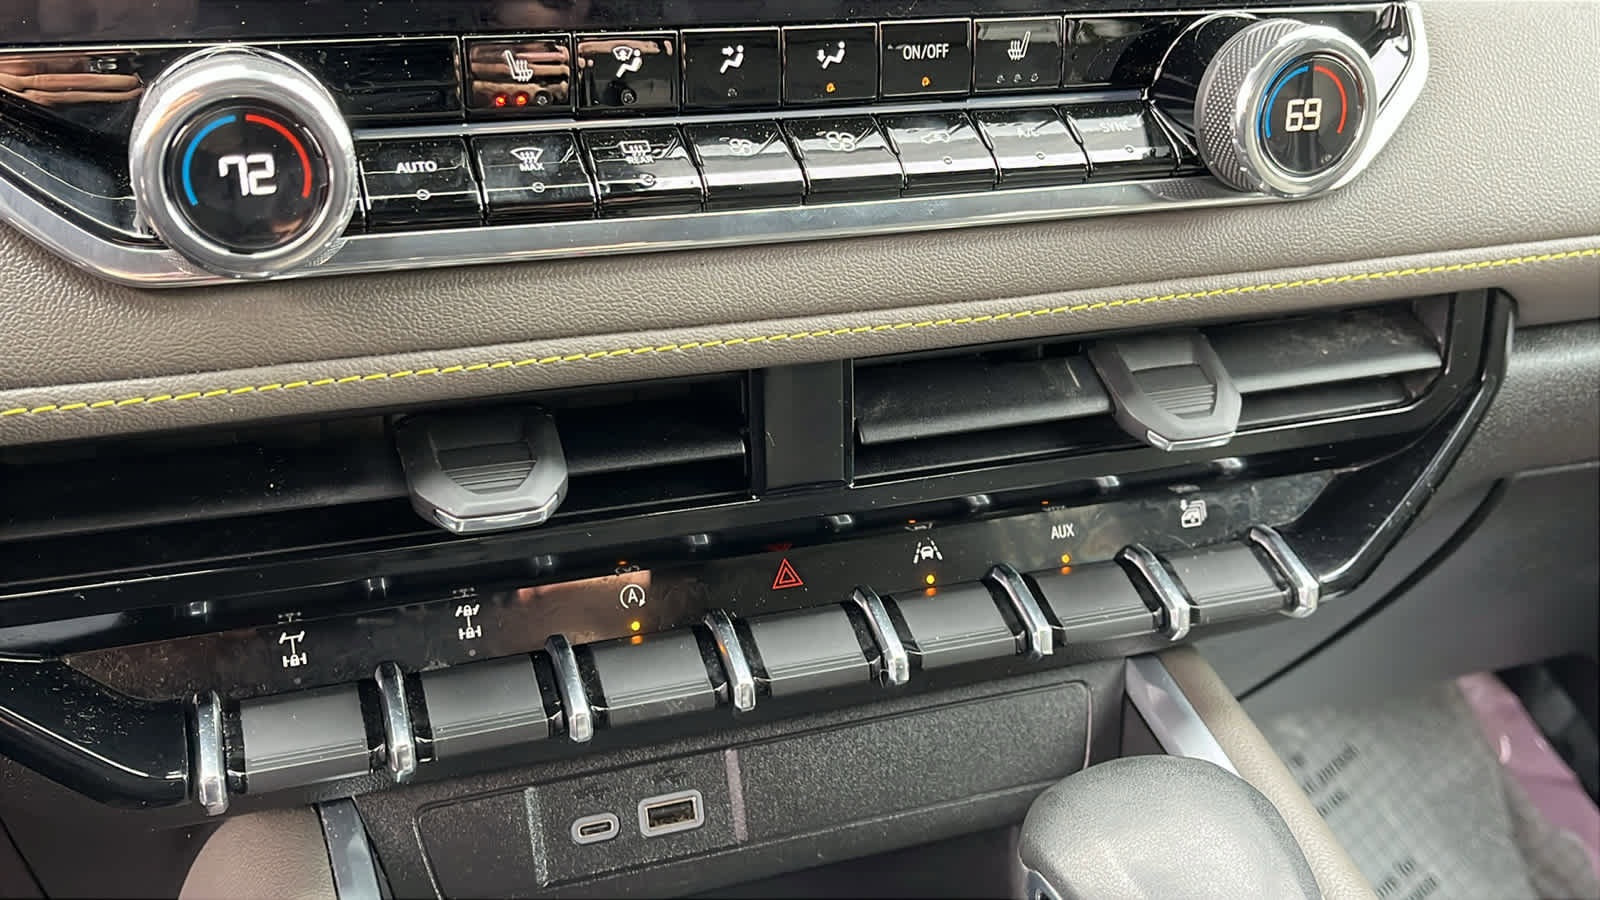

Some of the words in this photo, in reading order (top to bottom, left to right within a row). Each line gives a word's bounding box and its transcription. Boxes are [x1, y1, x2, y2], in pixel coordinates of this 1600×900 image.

[903, 44, 950, 60] ON/OFF
[1285, 98, 1322, 132] 69
[1099, 121, 1133, 133] SYNC
[627, 154, 654, 165] REAR
[396, 161, 437, 173] AUTO
[520, 162, 544, 172] MAX
[219, 155, 277, 196] 72
[1051, 524, 1075, 540] AUX
